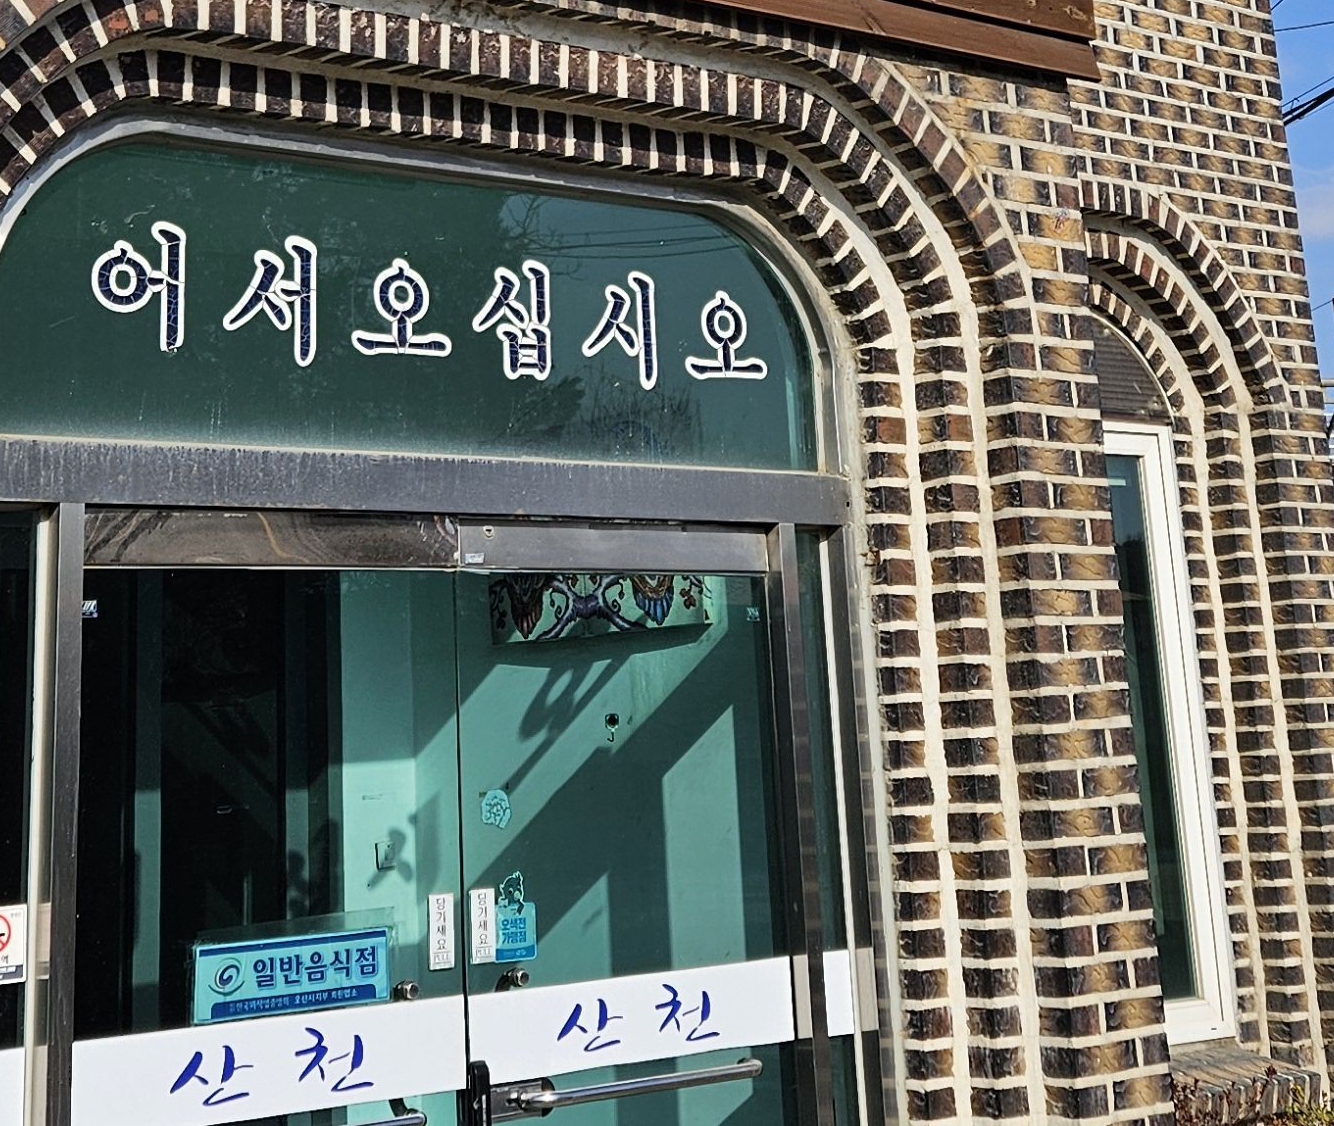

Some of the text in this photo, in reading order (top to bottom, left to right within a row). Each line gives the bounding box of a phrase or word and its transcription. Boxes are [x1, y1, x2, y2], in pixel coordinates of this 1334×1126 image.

[436, 897, 447, 951] 당기세요
[477, 892, 488, 946] 당기세요
[501, 917, 527, 931] 오색전
[501, 931, 527, 945] 가맹점
[253, 945, 378, 988] 일반음식점
